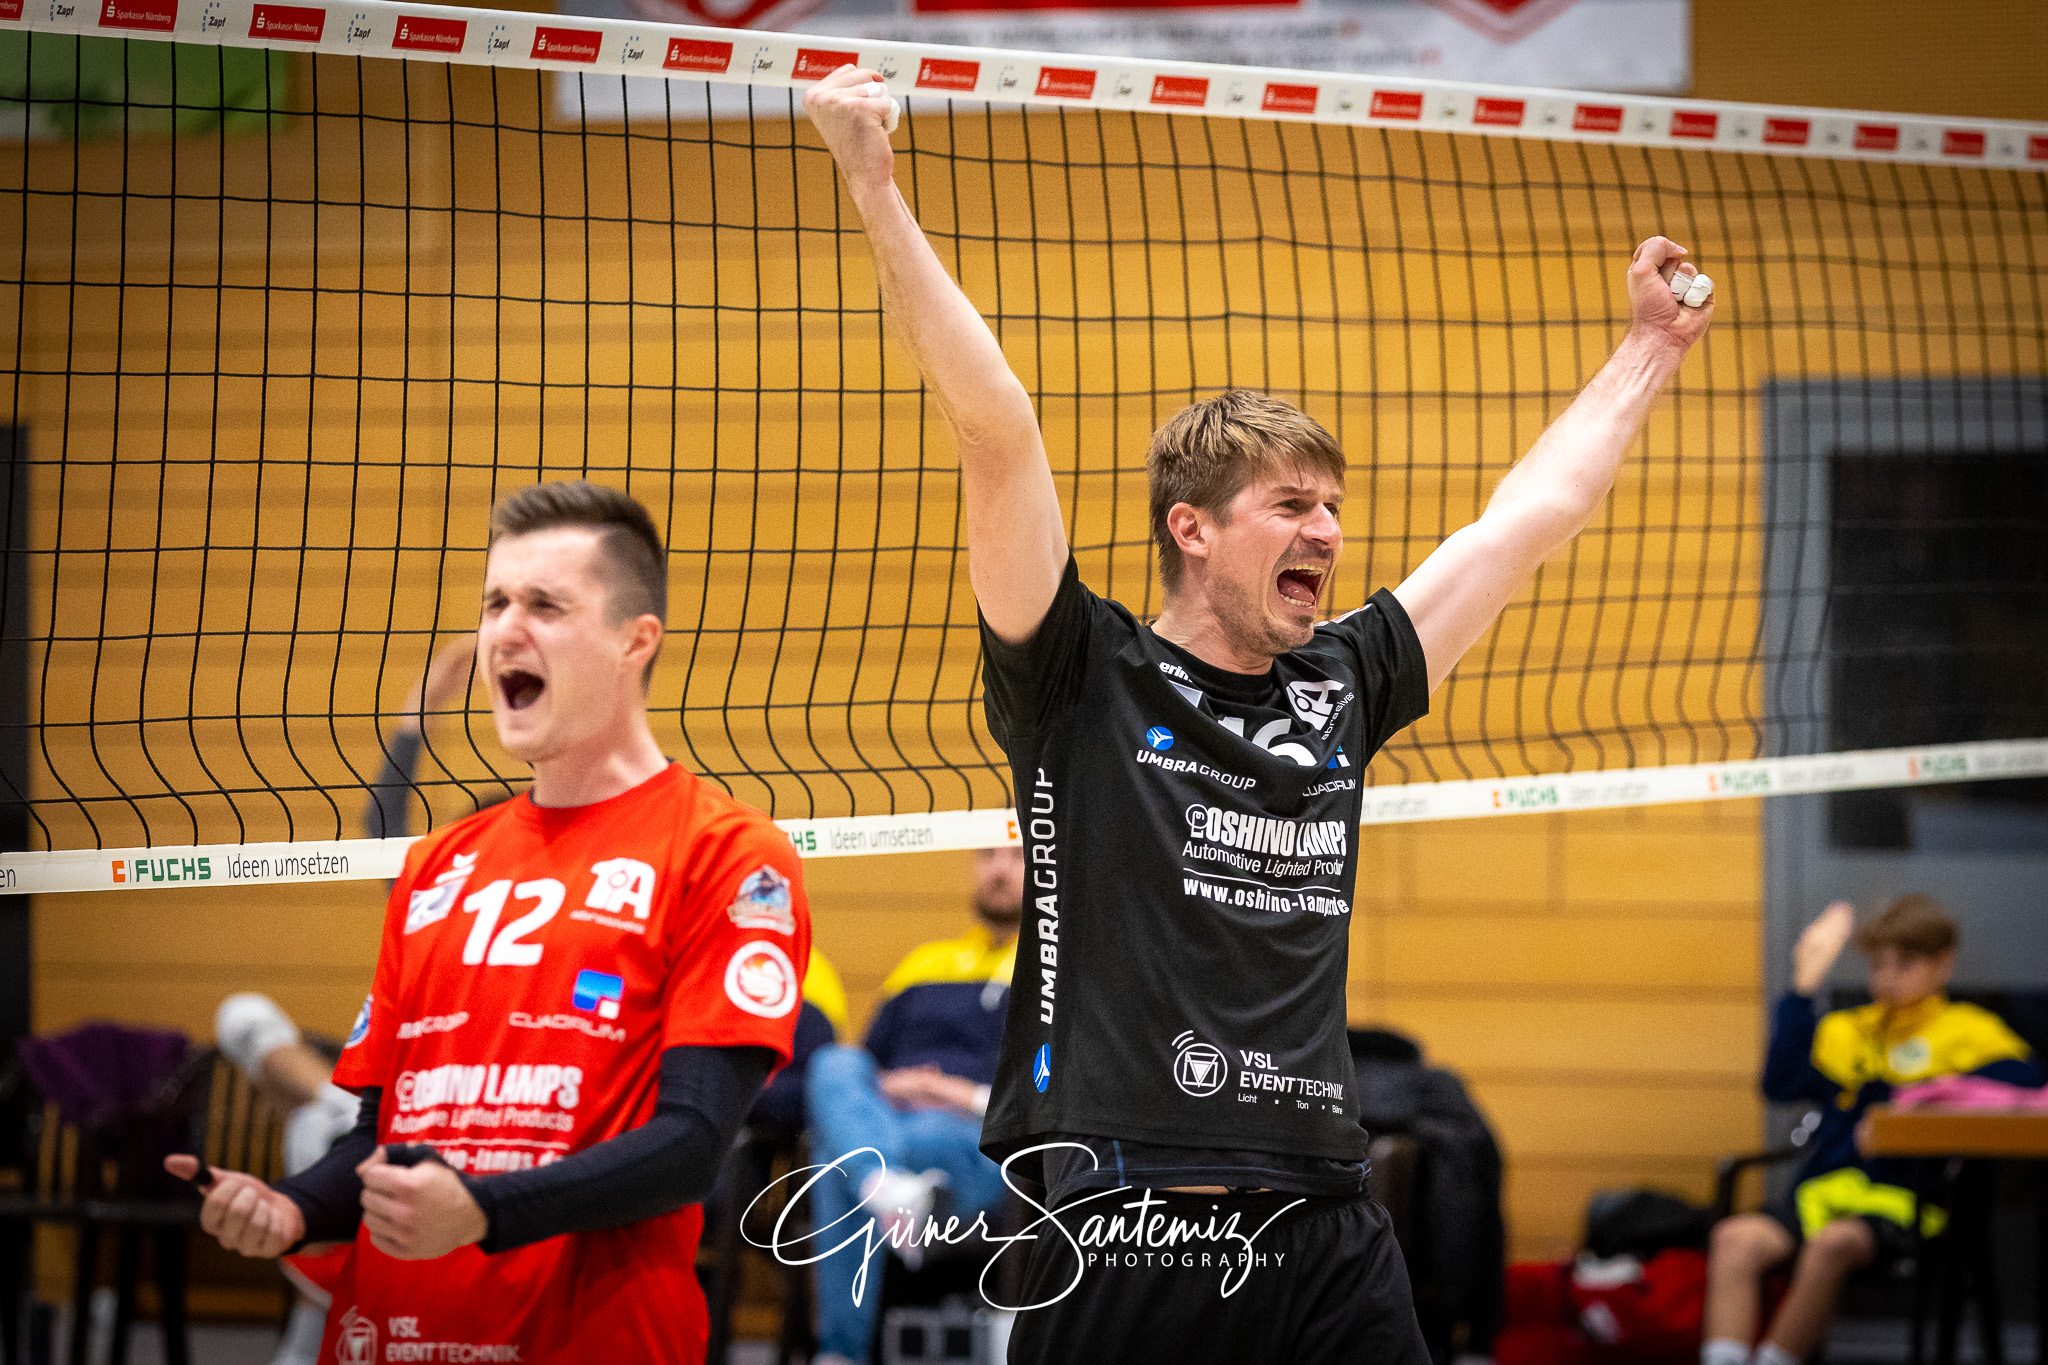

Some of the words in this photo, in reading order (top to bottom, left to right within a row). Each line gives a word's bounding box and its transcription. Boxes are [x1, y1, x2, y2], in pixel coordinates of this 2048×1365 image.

[0, 1, 18, 12] rnberg
[56, 5, 75, 18] Zapf
[117, 10, 145, 20] Sparkasse
[145, 12, 172, 24] Nürnberg
[208, 16, 227, 28] Zapf
[266, 21, 293, 31] Sparkasse
[293, 23, 319, 35] Nürnberg
[353, 27, 372, 39] Zapf
[409, 32, 435, 43] Sparkasse
[435, 34, 460, 46] Nürnberg
[493, 38, 511, 50] Zapf
[628, 49, 645, 60] Zapf
[757, 59, 774, 71] Zapf
[1136, 749, 1257, 790] UMBRAGROUP
[1206, 806, 1297, 857] OSHINO
[1182, 840, 1262, 874] Automotive
[1264, 858, 1313, 878] Lighted
[135, 857, 212, 883] FUCHS
[227, 853, 270, 879] Ideen
[274, 851, 349, 877] umsetzen
[461, 877, 567, 967] 12
[1239, 1049, 1279, 1071] VSL
[483, 1064, 584, 1110] LAMPS
[1237, 1093, 1257, 1104] Licht
[1296, 1099, 1309, 1110] Ton
